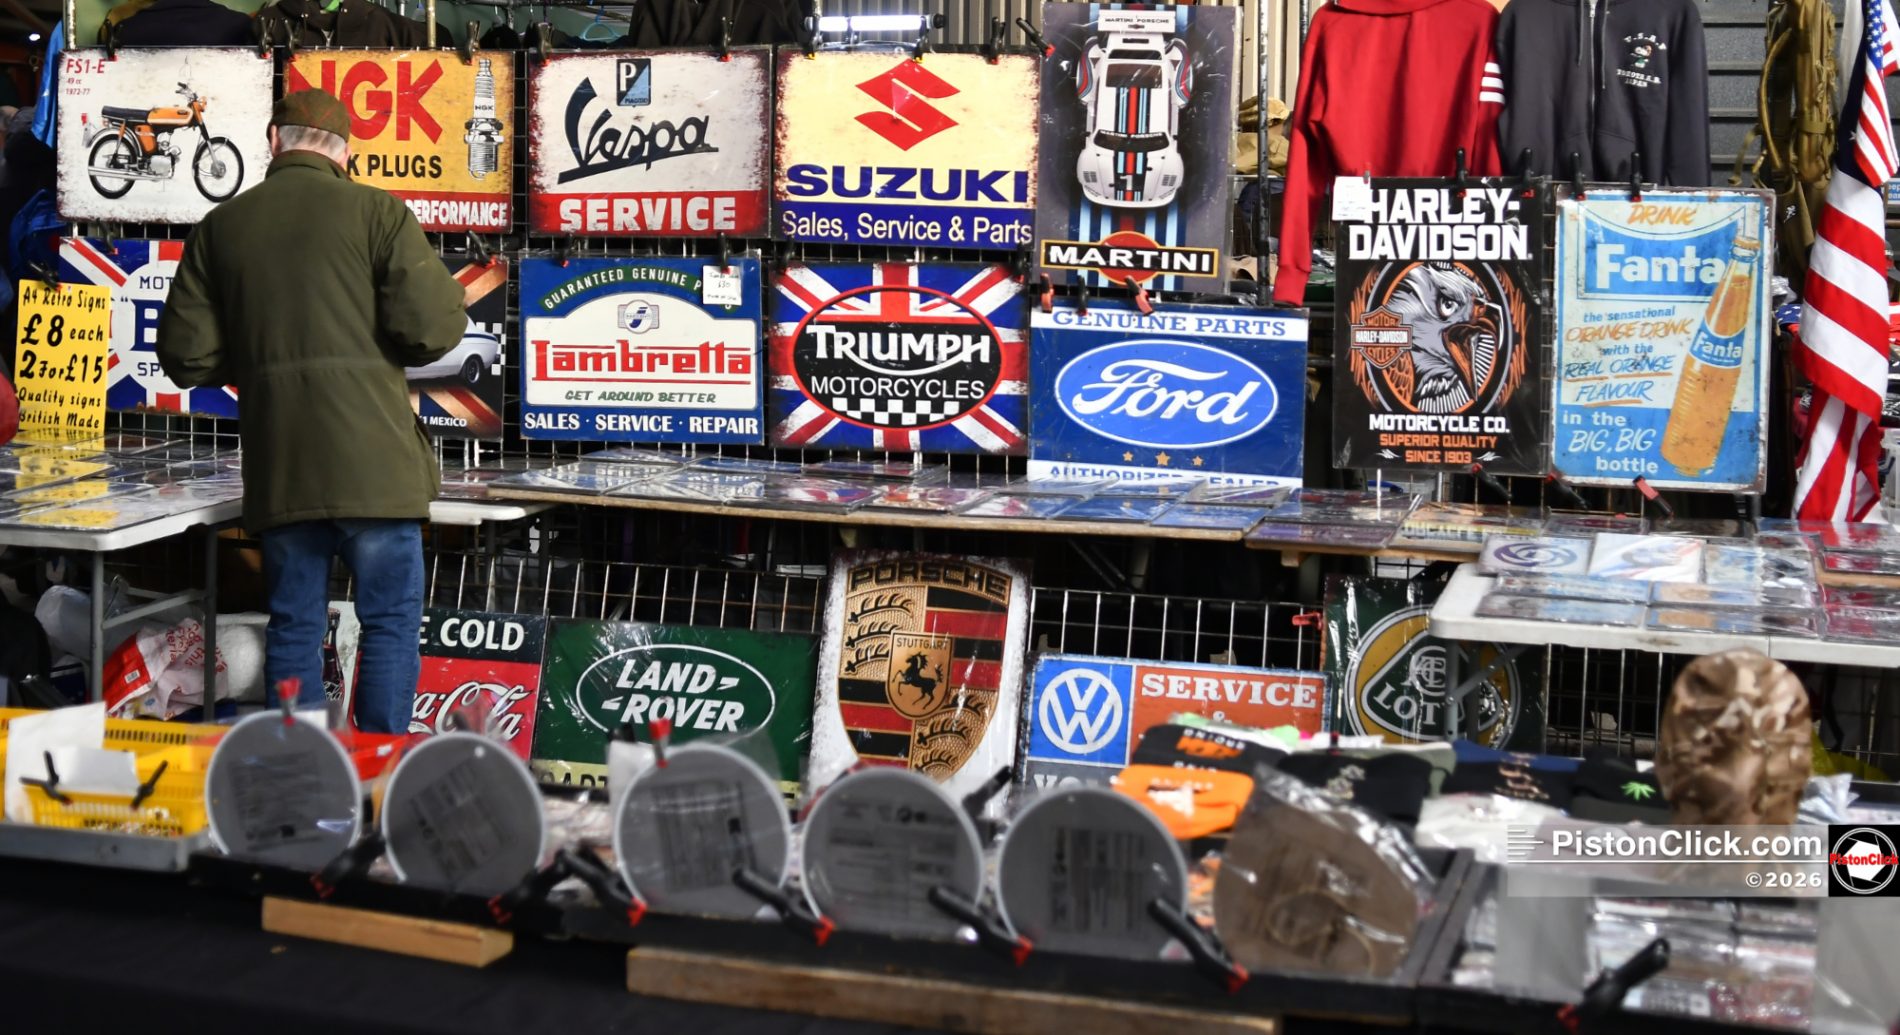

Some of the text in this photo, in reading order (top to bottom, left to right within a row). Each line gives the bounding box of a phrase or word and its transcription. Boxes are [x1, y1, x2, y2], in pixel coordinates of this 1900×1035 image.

[66, 58, 105, 74] FS1-E
[620, 62, 637, 91] P
[557, 77, 719, 184] Vespa
[367, 154, 443, 179] PLUGS
[786, 163, 1029, 203] SUZUKI
[1119, 174, 1133, 191] 1
[405, 199, 508, 227] PERFORMANCE
[559, 196, 737, 232] SERVICE
[1364, 188, 1520, 224] HARLEY-
[1626, 204, 1698, 226] DRINK
[782, 209, 1033, 245] Sales, Service & Parts
[1049, 245, 1211, 272] MARTINI
[1595, 243, 1727, 289] Fanta
[23, 285, 106, 312] A4 Retro Signs
[544, 267, 688, 309] GUARANTEED GENUINE
[1052, 310, 1286, 337] GENUINE PARTS
[1583, 306, 1676, 323] the sensational
[69, 325, 104, 341] each
[1565, 318, 1695, 343] ORANGE DRINK
[806, 324, 990, 376] TRIUMPH
[1600, 343, 1654, 356] with the
[1693, 331, 1743, 359] Fanta
[19, 350, 37, 379] 2
[65, 353, 104, 384] £15
[531, 340, 751, 385] Lambretta
[1563, 354, 1676, 379] REAL ORANGE
[18, 386, 101, 409] Quality signs
[565, 389, 716, 404] GET AROUND BETTER
[810, 375, 986, 399] MOTORCYCLES
[1072, 358, 1262, 425] Ford
[1575, 380, 1654, 402] FLAVOUR
[66, 411, 100, 429] Made
[429, 415, 467, 428] MEXICO
[524, 412, 759, 435] SALES SERVICE REPAIR
[1369, 414, 1510, 433] MOTORCYCLE CO.
[1562, 410, 1627, 427] in the
[1379, 433, 1498, 449] SUPERIOR QUALITY
[1567, 428, 1657, 453] BIG, BIG
[1405, 450, 1472, 464] SINCE 1903
[1595, 456, 1659, 474] bottle
[1050, 465, 1184, 482] AUTHORI
[850, 559, 1009, 603] PORSCHE
[440, 617, 525, 652] COLD
[896, 637, 950, 651] STUTTGART
[615, 658, 717, 695] LAND
[1141, 673, 1318, 709] SERVICE
[1372, 681, 1442, 726] LOT
[411, 681, 536, 742] a-Cola
[620, 693, 745, 733] ROVER
